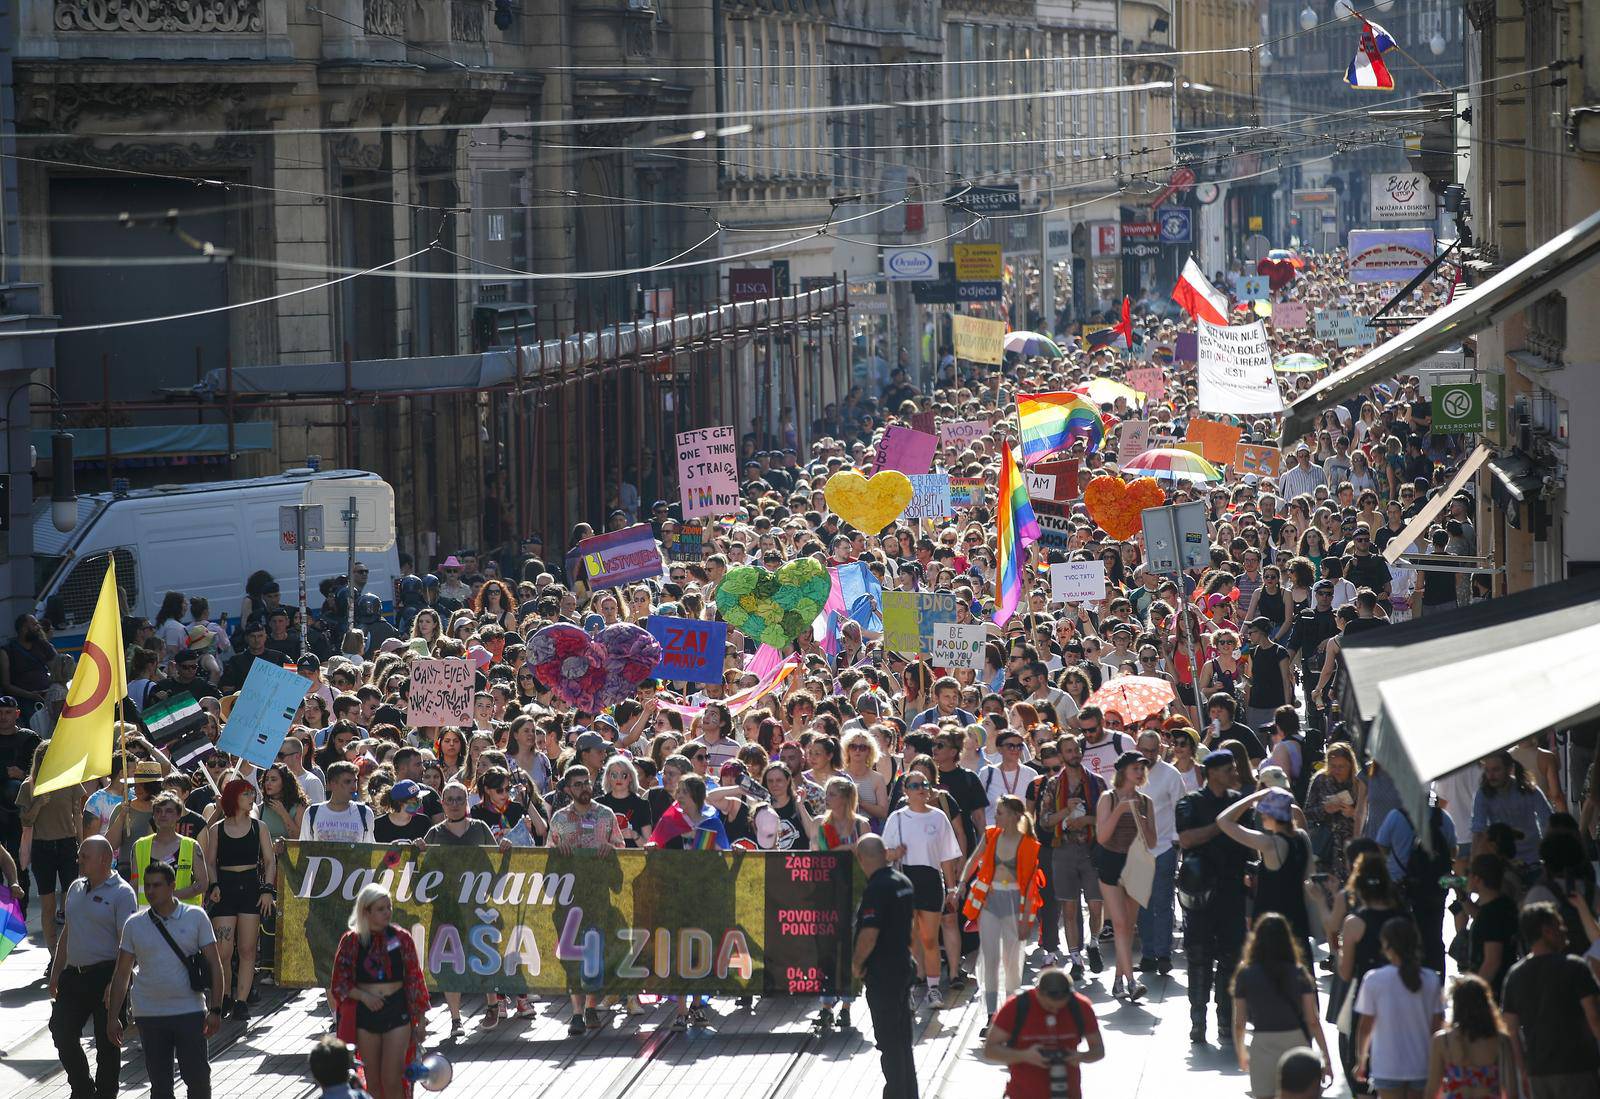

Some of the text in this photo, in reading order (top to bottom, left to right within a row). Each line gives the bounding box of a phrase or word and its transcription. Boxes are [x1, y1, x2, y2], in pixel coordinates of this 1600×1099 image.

[1123, 224, 1152, 235] Triumph
[895, 257, 926, 267] Oculus
[736, 283, 768, 294] LISCA
[959, 285, 997, 297] odjeća
[1330, 320, 1339, 329] SU
[1218, 331, 1239, 342] KVIR
[1240, 328, 1260, 342] NIJE
[1453, 422, 1482, 430] ROCHER
[678, 426, 734, 446] LET'S GET
[680, 443, 735, 460] ONE THING
[687, 462, 738, 483] STRAIGHT
[1032, 478, 1050, 490] AM
[688, 485, 739, 510] I'M NOT
[949, 626, 964, 639] BE
[937, 640, 986, 653] PROUD OF
[935, 651, 973, 661] WHO YOU
[949, 659, 972, 668] ARE!
[443, 664, 470, 683] EVEN
[435, 685, 474, 718] STRAIGHT
[785, 856, 837, 868] ZAGREB
[791, 869, 830, 881] PRIDE
[458, 869, 576, 906] nam
[778, 909, 839, 922] POVORKA
[781, 922, 835, 935] PONOSA
[556, 907, 604, 980] 4
[616, 927, 753, 979] ZIDA
[788, 980, 820, 992] 2022
